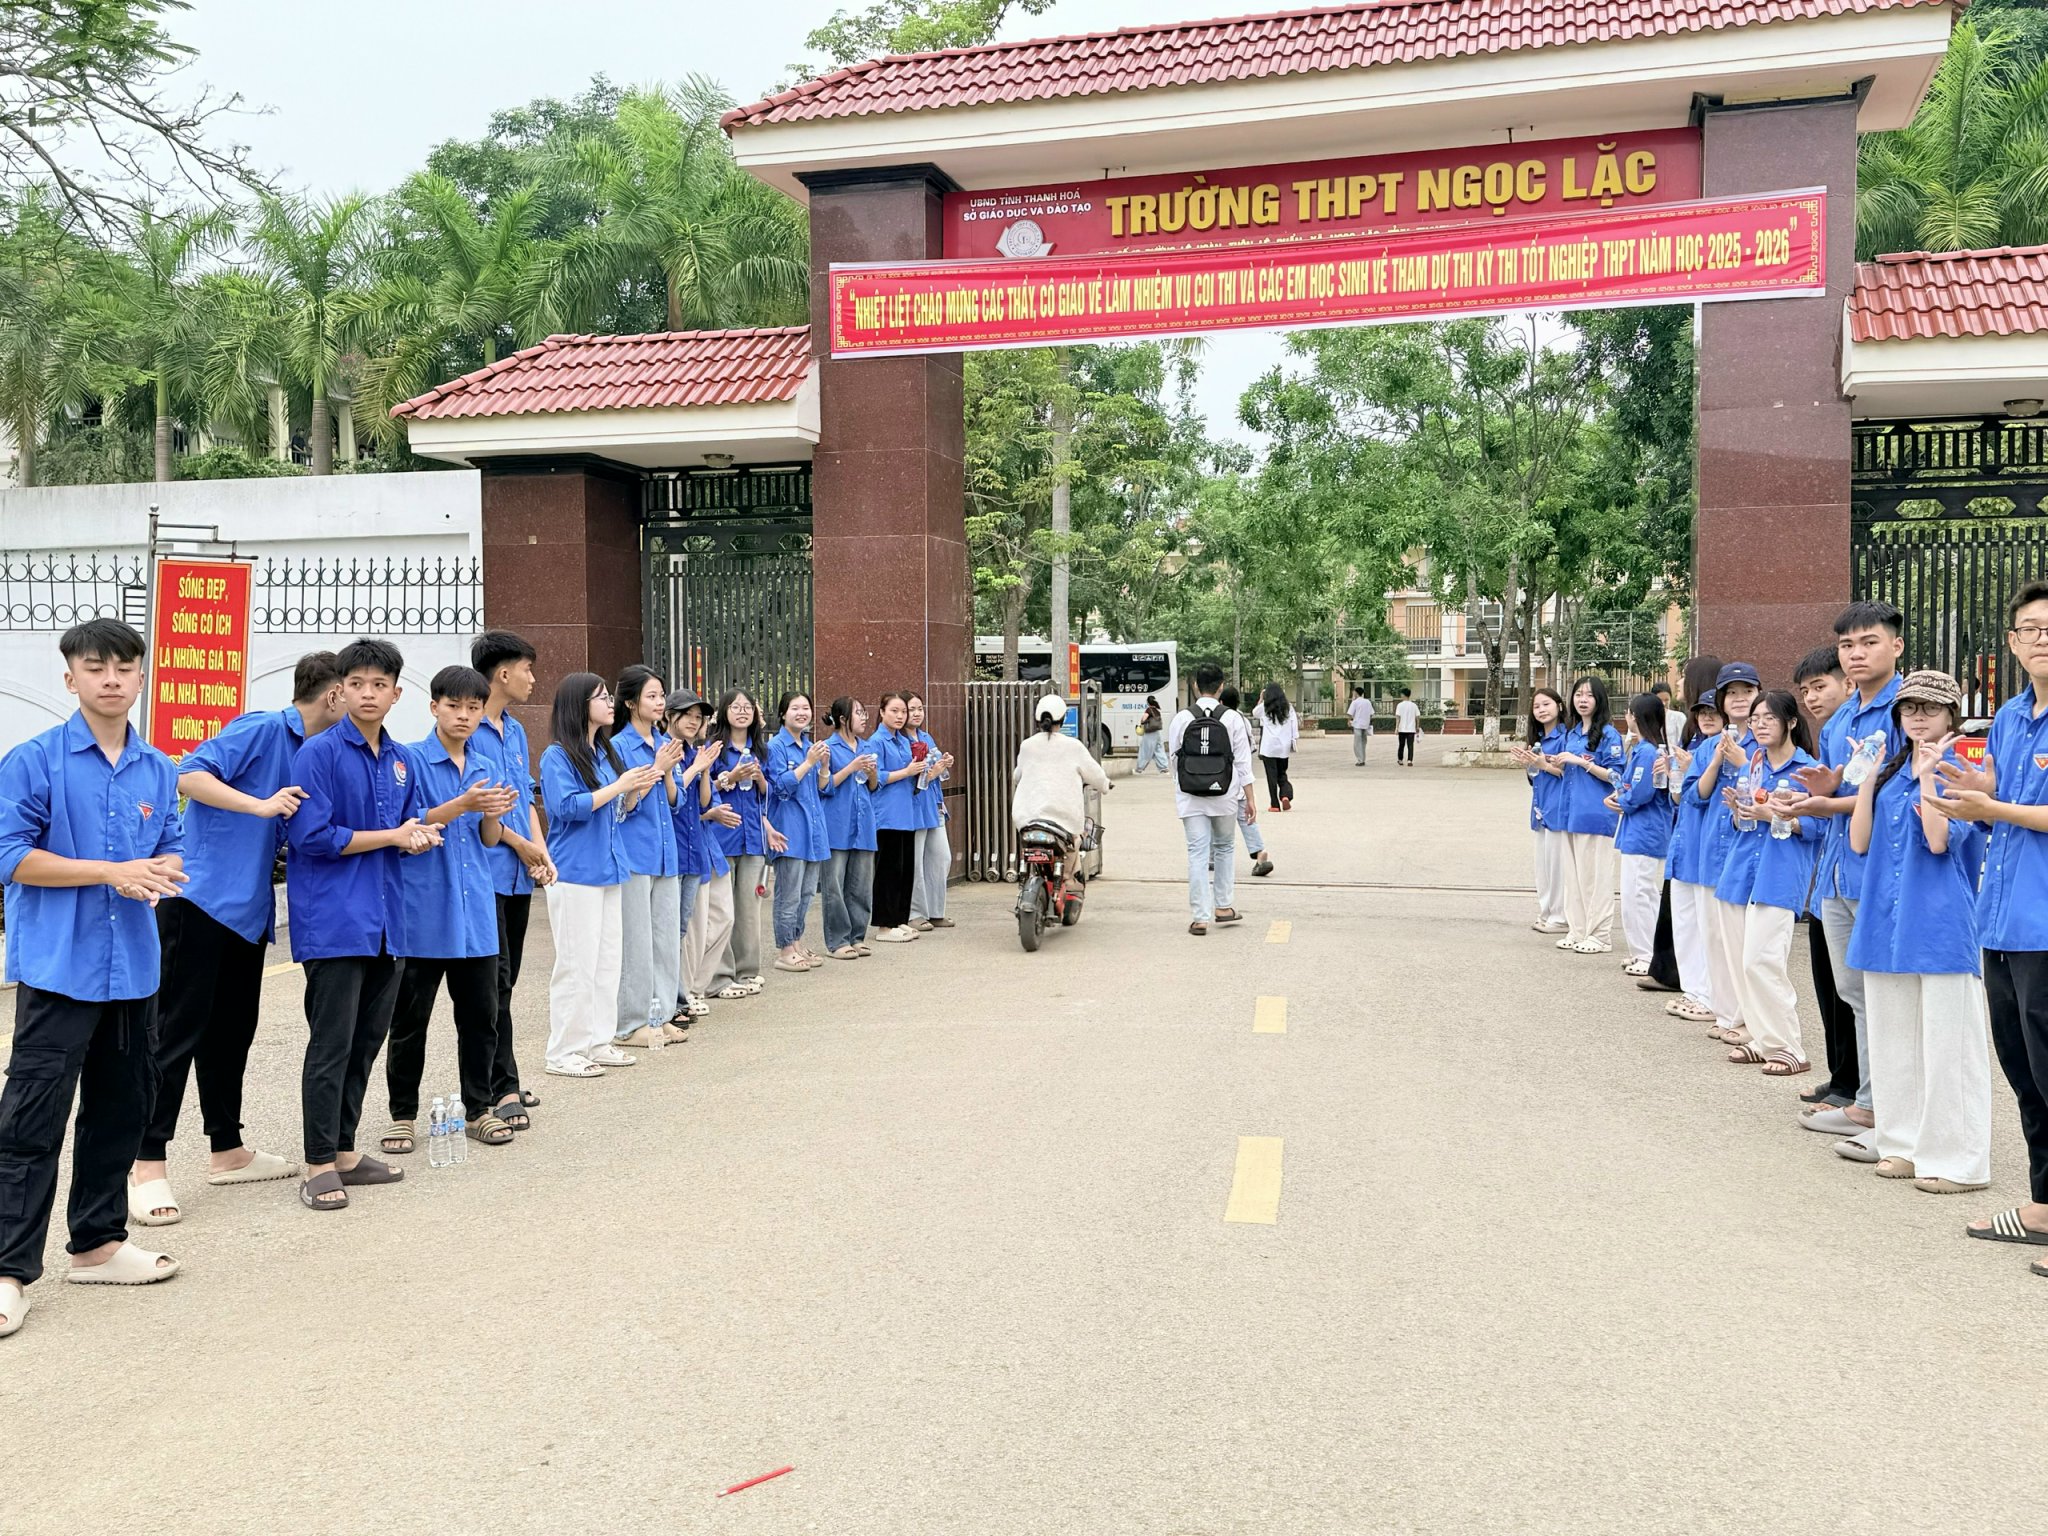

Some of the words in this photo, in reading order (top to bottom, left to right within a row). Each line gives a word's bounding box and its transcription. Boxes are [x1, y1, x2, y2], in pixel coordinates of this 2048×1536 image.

[970, 197, 997, 207] UBND
[999, 193, 1022, 206] TỈNH
[1024, 192, 1058, 204] THANH
[1060, 188, 1081, 201] HOÁ
[1105, 175, 1280, 237] TRƯỜNG
[1292, 172, 1404, 222] THPT
[1417, 159, 1547, 216] NGỌC
[1562, 142, 1657, 209] LẶC
[963, 208, 977, 222] SỞ
[979, 206, 1004, 220] GIÁO
[1008, 207, 1028, 220] DỤC
[1031, 203, 1045, 216] VÀ
[1046, 203, 1069, 215] ĐÀO
[1071, 202, 1092, 216] TẠO
[889, 286, 911, 335] LIỆT
[913, 285, 942, 327] CHÀO
[946, 283, 979, 325] MỪNG
[982, 280, 1004, 322] CÁC
[1007, 274, 1036, 323] THẦY,
[1040, 277, 1055, 318] CÔ
[1058, 275, 1085, 317] GIÁO
[1088, 268, 1102, 315] VỀ
[1105, 272, 1130, 313] LÀM
[1133, 268, 1172, 318] NHIỆM
[1175, 274, 1191, 316] VỤ
[1194, 272, 1215, 308] COI
[1217, 270, 1237, 306] THI
[1240, 261, 1255, 304] VÀ
[1259, 259, 1283, 303] CÁC
[1286, 265, 1307, 301] EM
[1309, 262, 1335, 307] HỌC
[1338, 260, 1369, 297] SINH
[1372, 246, 1388, 294] VỀ
[1391, 255, 1428, 293] THAM
[1431, 249, 1451, 298] DỰ
[1453, 251, 1473, 289] THI
[1476, 242, 1494, 287] KỲ
[1497, 248, 1518, 285] THI
[1521, 233, 1545, 284] TỐT
[1548, 234, 1599, 287] NGHIỆP
[1602, 239, 1636, 278] THPT
[1639, 229, 1671, 275] NĂM
[1675, 233, 1704, 279] HỌC
[1707, 231, 1742, 270] 2025
[178, 570, 204, 599] SỐNG
[206, 578, 229, 604] ĐẸP,
[172, 605, 198, 634] SỐNG
[200, 609, 213, 635] CÓ
[215, 609, 232, 636] ÍCH
[159, 642, 171, 668] LÀ
[173, 644, 205, 670] NHỮNG
[208, 645, 224, 672] GIÁ
[226, 650, 241, 677] TRỊ
[160, 678, 175, 704] MÀ
[177, 678, 197, 705] NHÀ
[199, 680, 237, 708] TRƯỜNG
[172, 714, 205, 741] HƯỚNG
